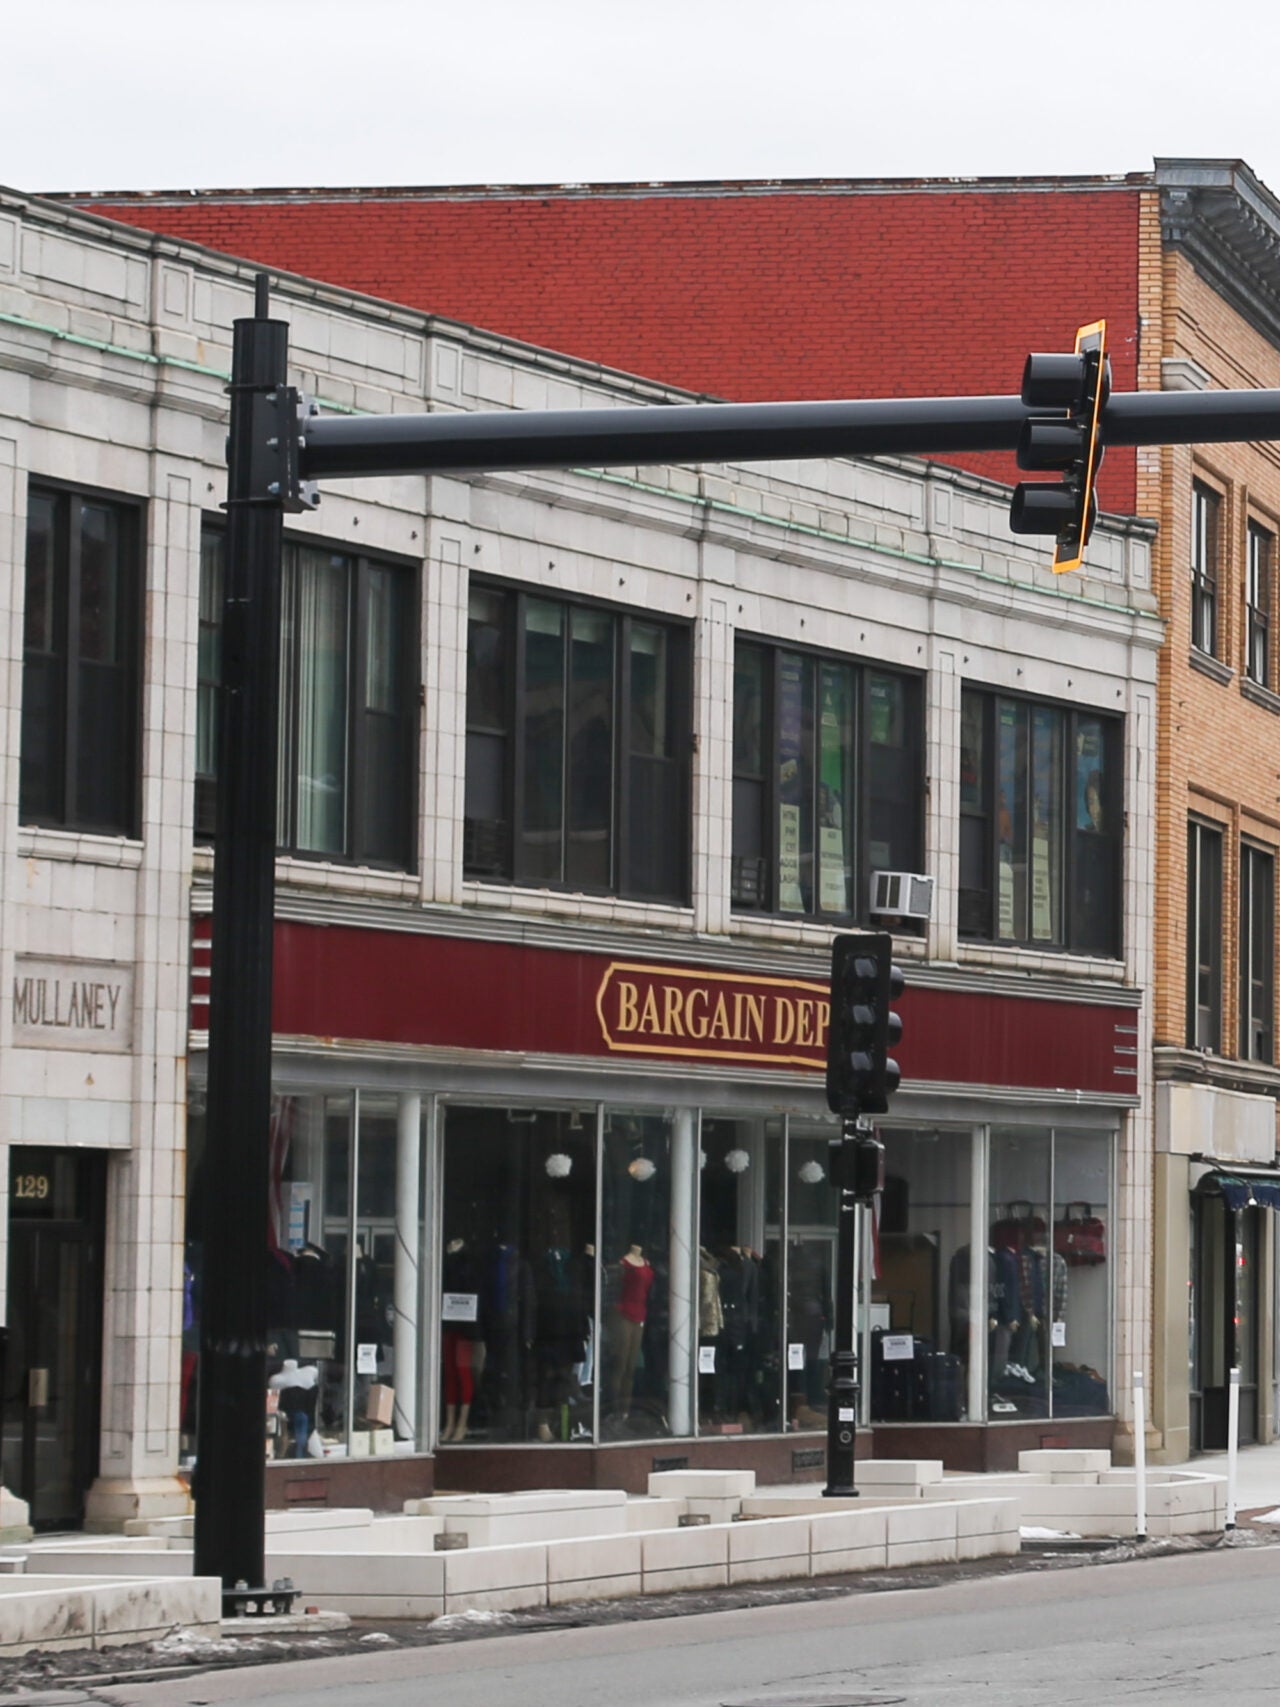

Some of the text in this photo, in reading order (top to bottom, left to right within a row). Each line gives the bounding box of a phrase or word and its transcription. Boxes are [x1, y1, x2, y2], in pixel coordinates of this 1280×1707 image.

[13, 977, 121, 1030] MULLANEY
[617, 981, 831, 1047] BARGAIN DEP
[16, 1175, 48, 1199] 129
